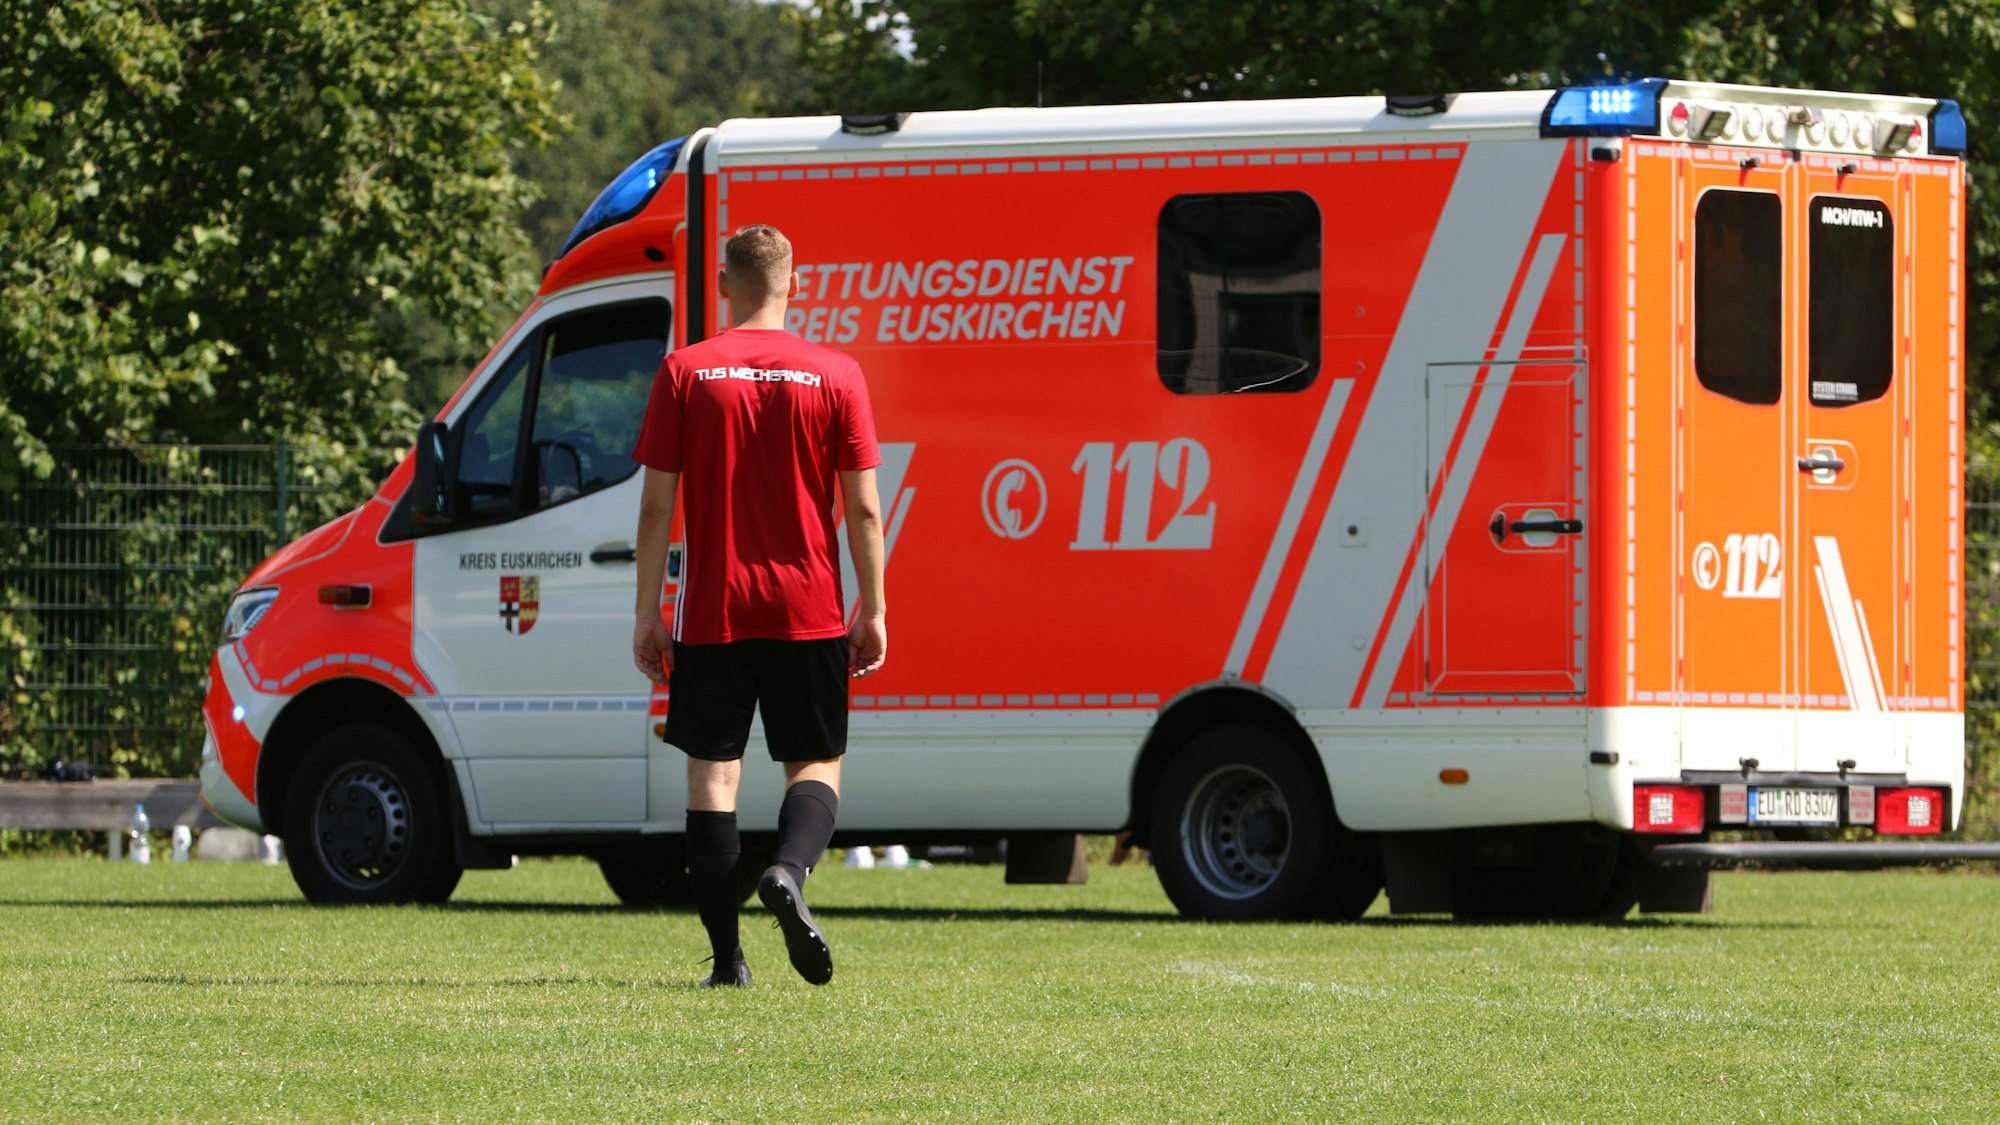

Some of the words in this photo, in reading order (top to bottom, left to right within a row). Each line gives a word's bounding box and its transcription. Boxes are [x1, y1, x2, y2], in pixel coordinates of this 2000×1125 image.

[1821, 206, 1883, 228] MCH/RTW-1
[795, 256, 1134, 300] ETTUNGSDIENST
[784, 305, 860, 344] REIS
[876, 299, 1126, 342] EUSKIRCHEN
[695, 367, 726, 381] TUS
[728, 366, 821, 387] MECHERNICH
[1069, 437, 1217, 551] 112
[459, 552, 497, 570] KREIS
[501, 551, 582, 569] EUSKIRCHEN
[1722, 532, 1782, 599] 112
[1758, 790, 1775, 815] EU
[1786, 791, 1801, 816] RD
